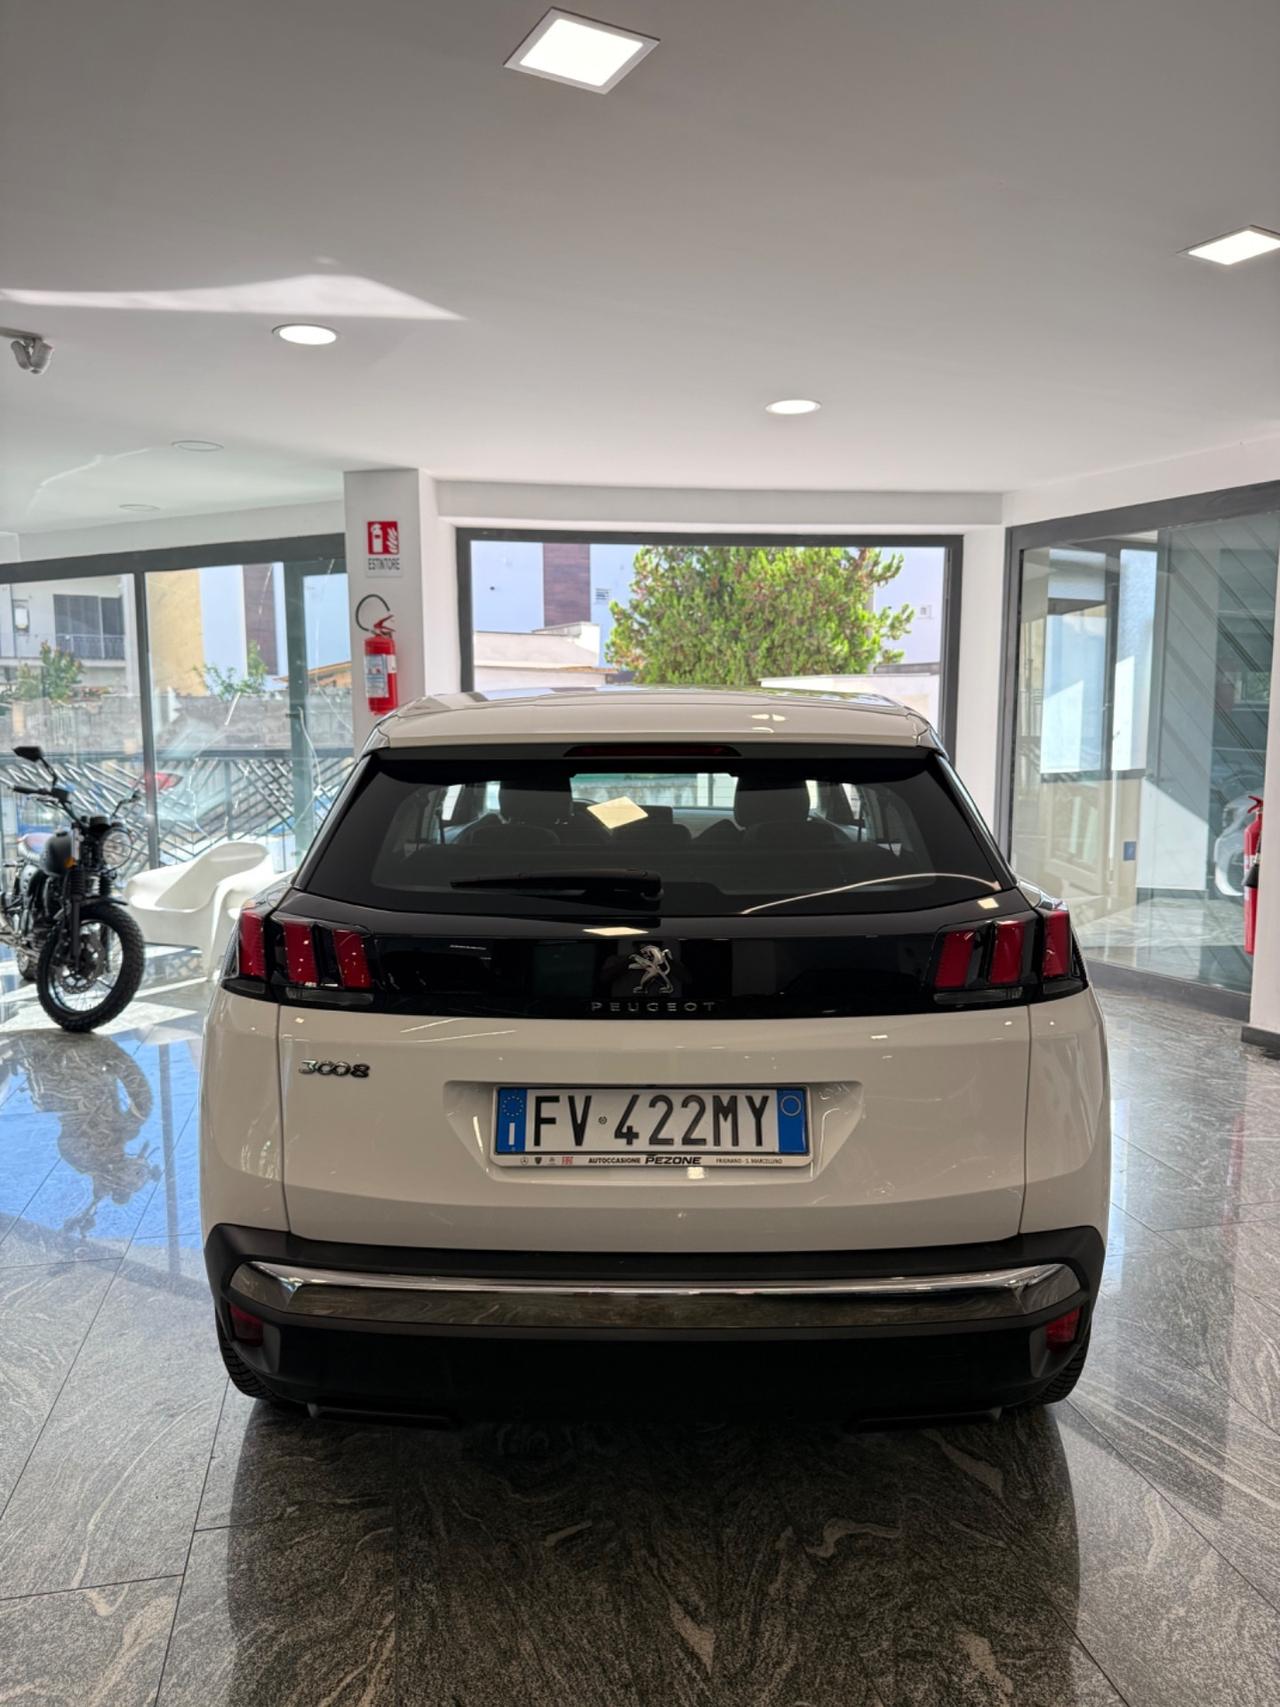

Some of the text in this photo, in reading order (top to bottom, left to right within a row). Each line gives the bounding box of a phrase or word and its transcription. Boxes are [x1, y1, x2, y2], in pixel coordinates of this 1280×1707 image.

[591, 1002, 715, 1011] PEUGEOT
[299, 1060, 370, 1078] 3008
[533, 1094, 770, 1147] FV 422MY
[645, 1156, 702, 1165] PEZONE
